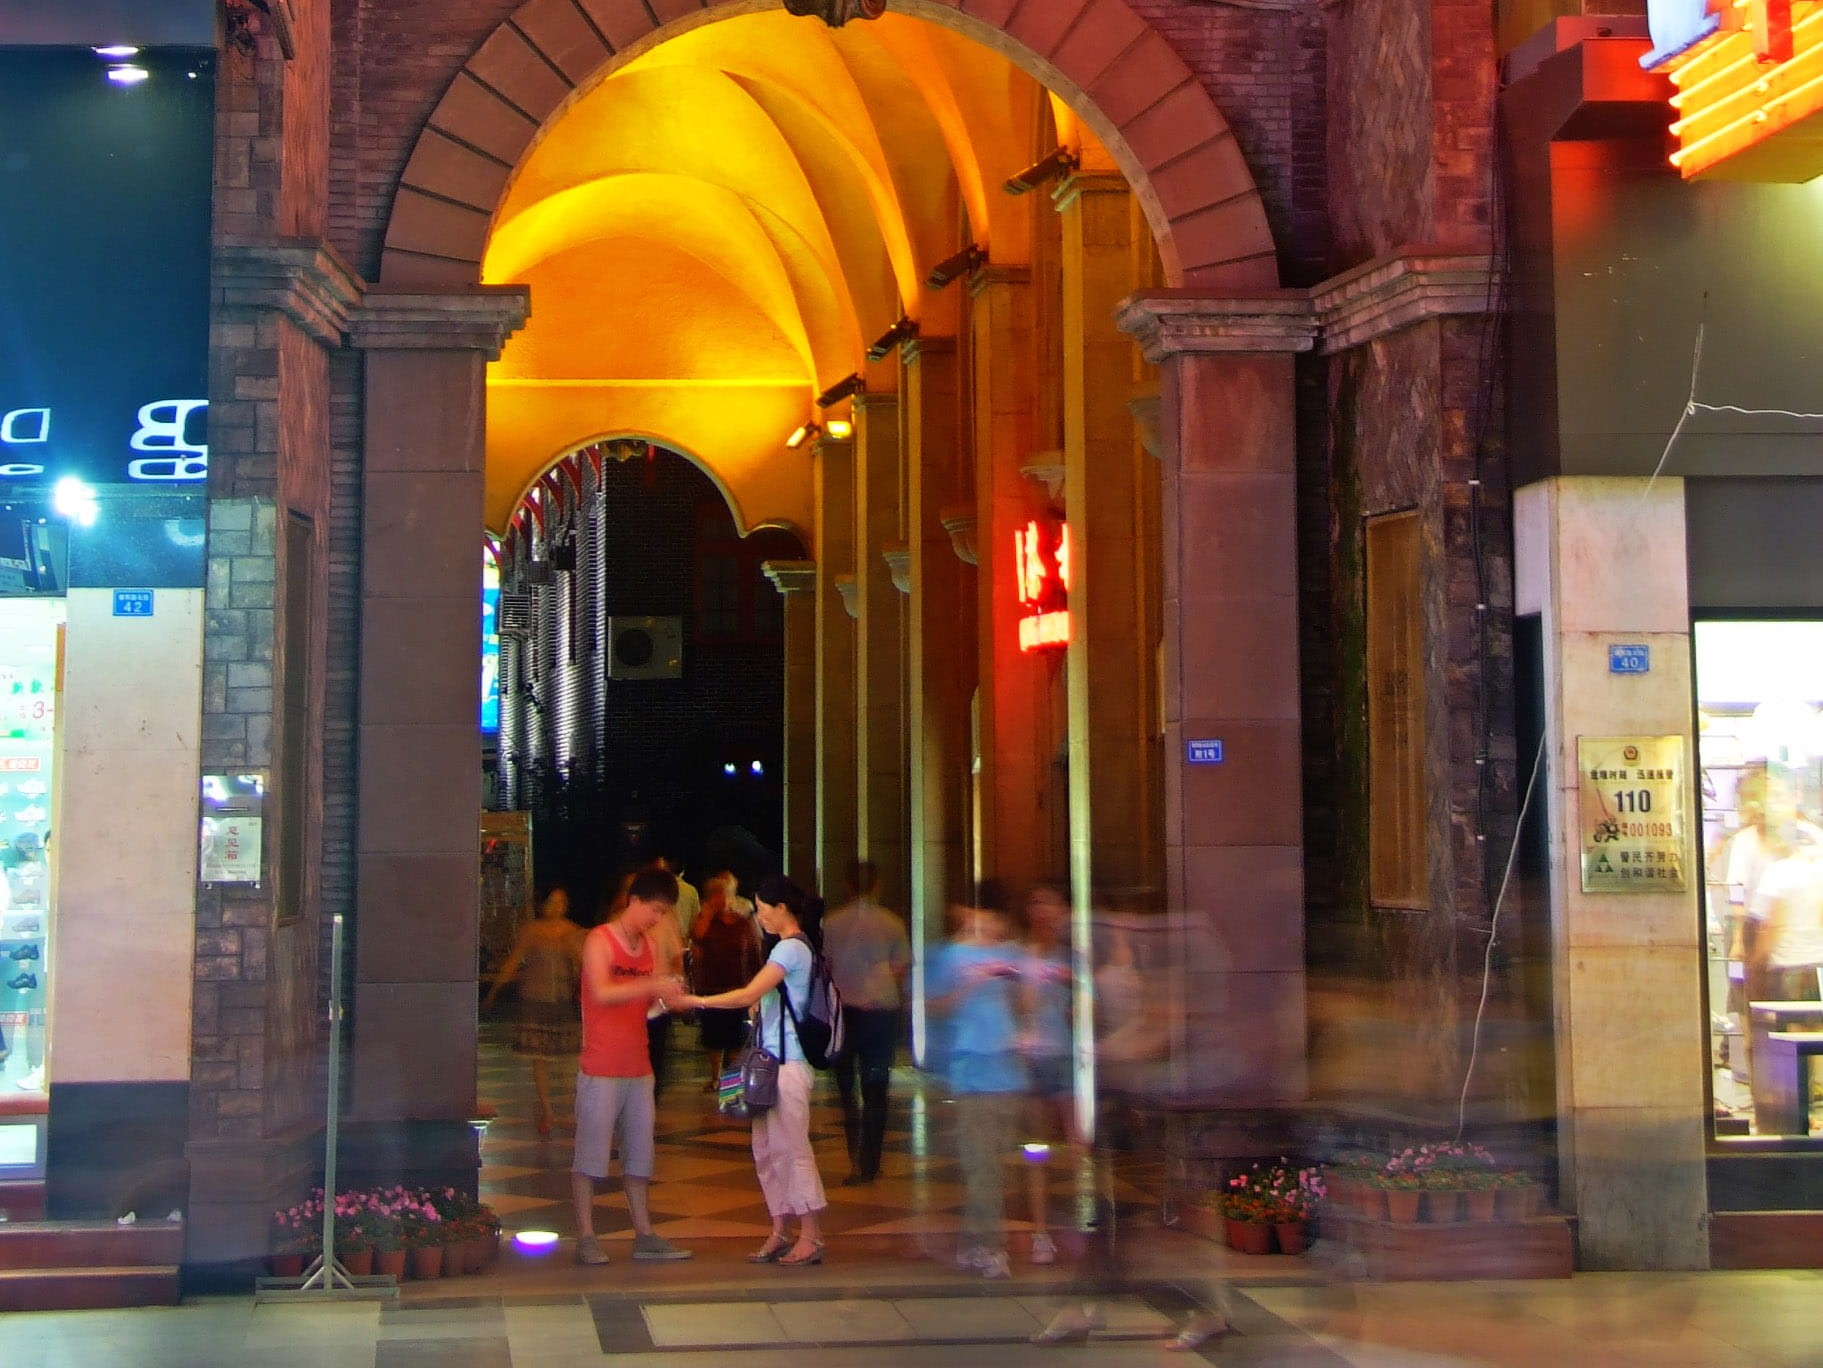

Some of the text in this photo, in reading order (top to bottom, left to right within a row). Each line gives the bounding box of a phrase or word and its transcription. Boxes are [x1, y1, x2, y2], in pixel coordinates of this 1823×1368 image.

[123, 601, 142, 612] 42
[1620, 657, 1639, 668] 40
[1614, 790, 1651, 813] 110
